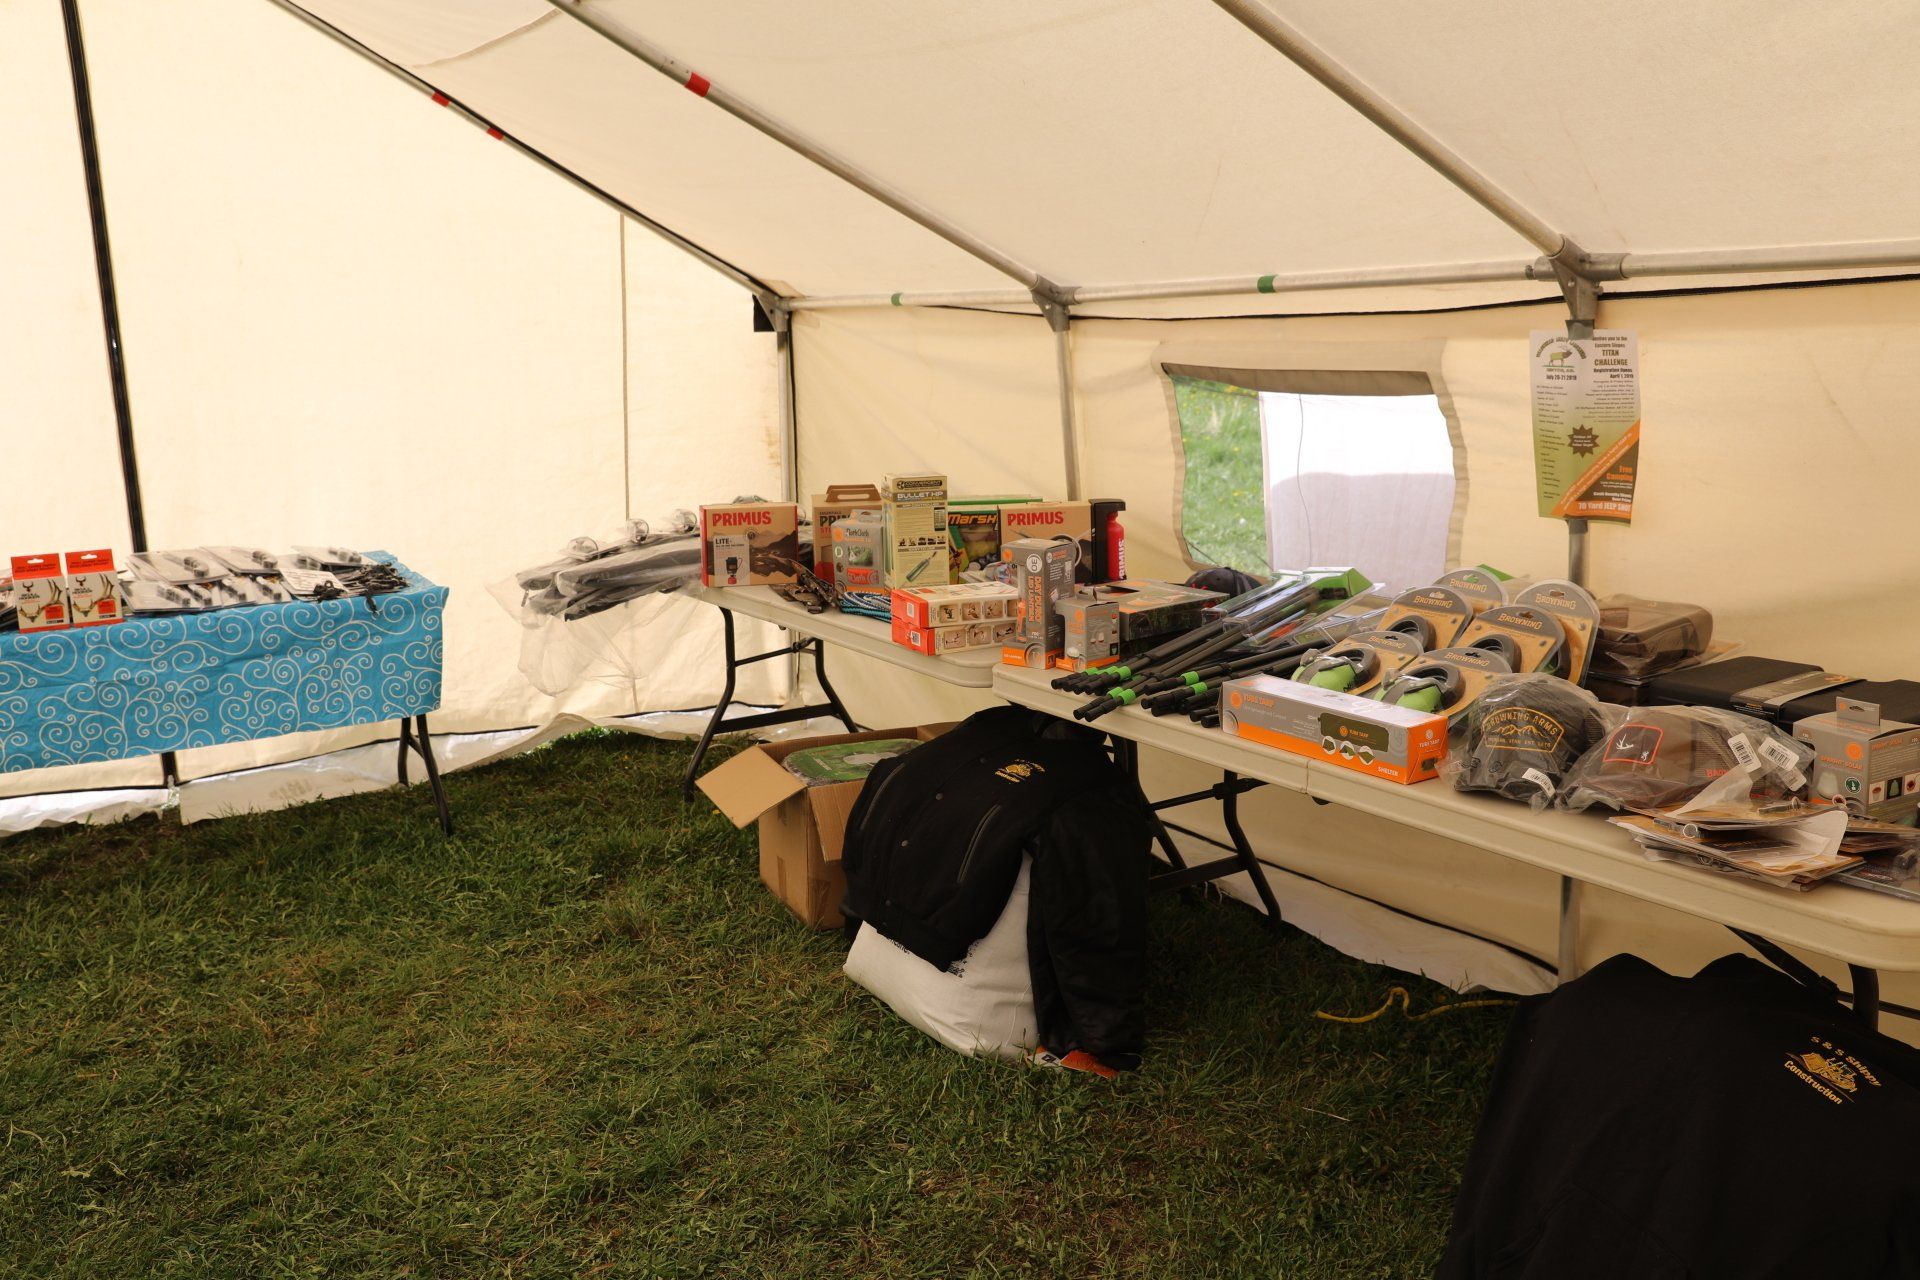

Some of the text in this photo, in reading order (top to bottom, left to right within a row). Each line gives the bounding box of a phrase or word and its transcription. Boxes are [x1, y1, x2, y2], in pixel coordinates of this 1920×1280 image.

[712, 511, 772, 526] PRIMUS
[1007, 512, 1064, 526] PRIMUS
[1031, 558, 1038, 571] 30
[1450, 578, 1488, 593] BROWNING
[1414, 595, 1453, 608] BROWNING
[1535, 594, 1576, 610] BROWNING
[1498, 613, 1542, 630] BROWNING
[1368, 635, 1406, 648] BROWNING
[1445, 652, 1490, 667] BROWNING
[1486, 712, 1558, 735] BROWNING ARMS
[1846, 1056, 1882, 1087] Shippy
[1784, 1060, 1842, 1104] Construction
